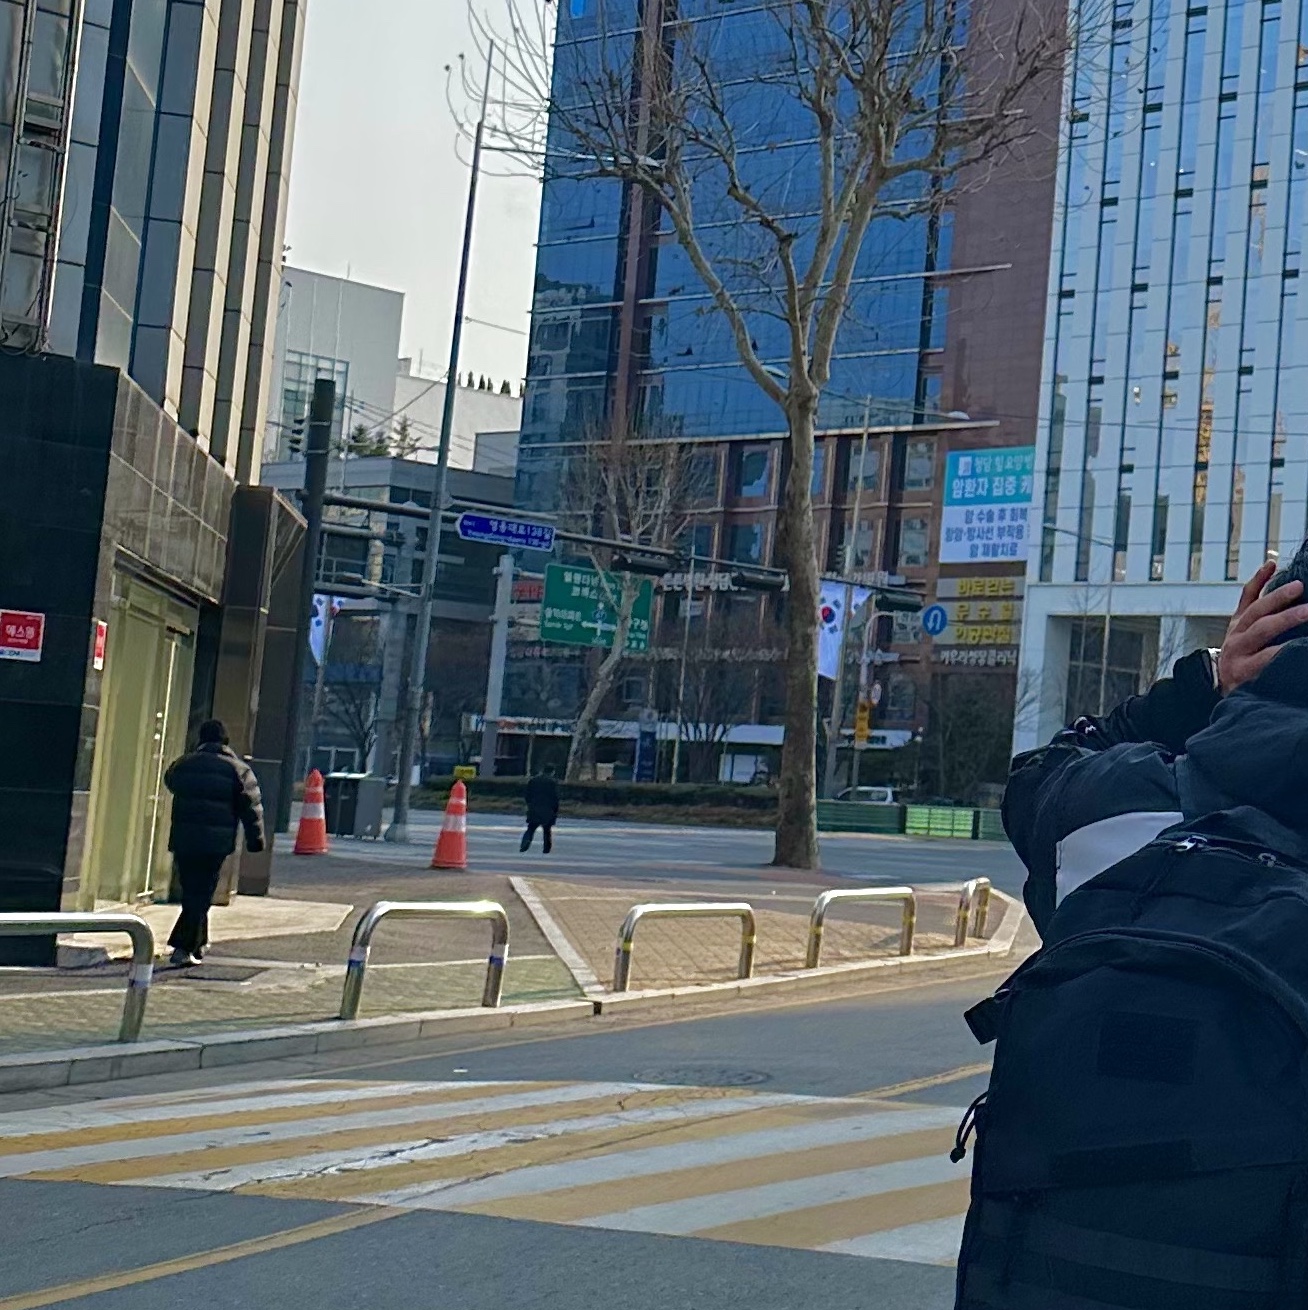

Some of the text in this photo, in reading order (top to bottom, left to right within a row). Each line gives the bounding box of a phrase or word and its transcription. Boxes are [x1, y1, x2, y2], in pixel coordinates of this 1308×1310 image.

[952, 478, 989, 499] 암환자
[992, 476, 1017, 496] 집중
[977, 509, 994, 523] 수술
[997, 524, 1024, 540] 부작용
[5, 624, 35, 639] 에스원
